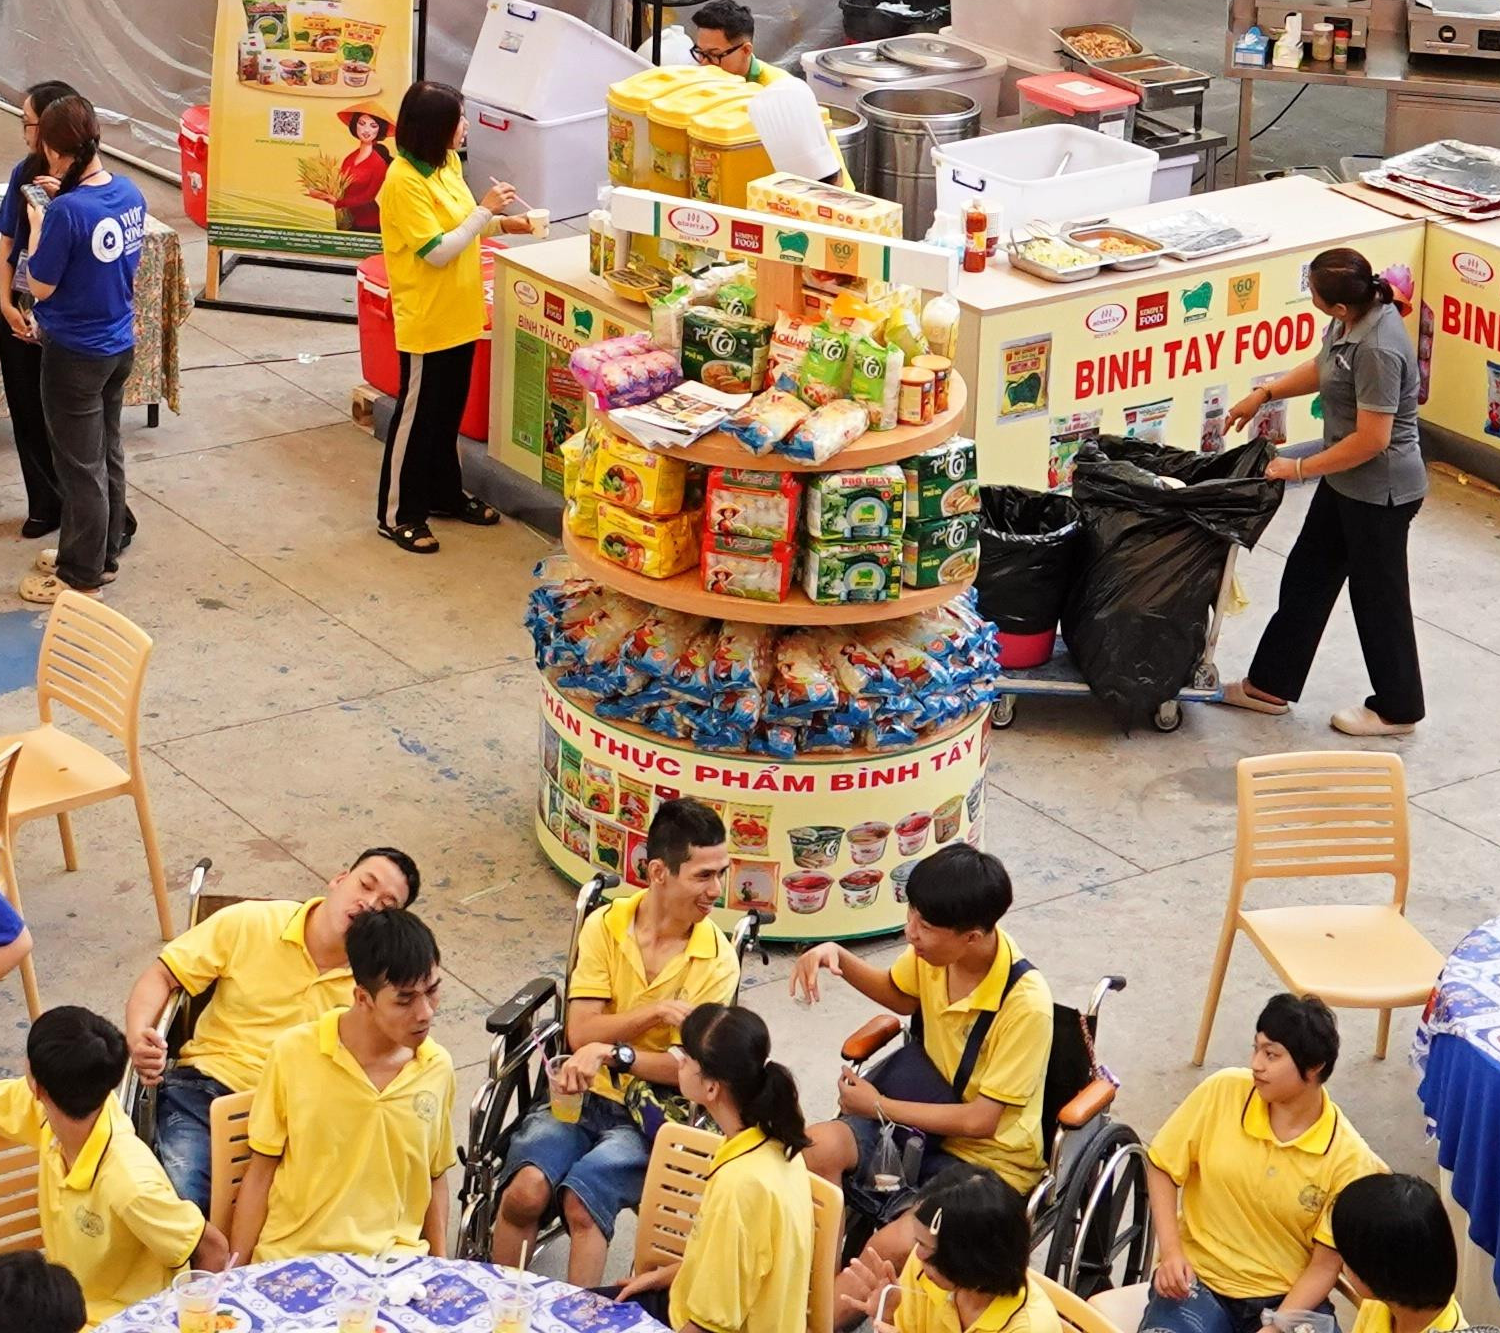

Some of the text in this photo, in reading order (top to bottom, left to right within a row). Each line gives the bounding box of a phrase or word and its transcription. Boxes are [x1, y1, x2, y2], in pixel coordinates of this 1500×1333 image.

[734, 237, 760, 249] FOOD
[834, 243, 851, 257] 60
[1236, 277, 1252, 293] 60
[1139, 313, 1164, 327] FOOD
[1073, 312, 1316, 401] BINH TAY FOOD
[589, 727, 976, 793] THỰC PHẨM BÌNH TÂY
